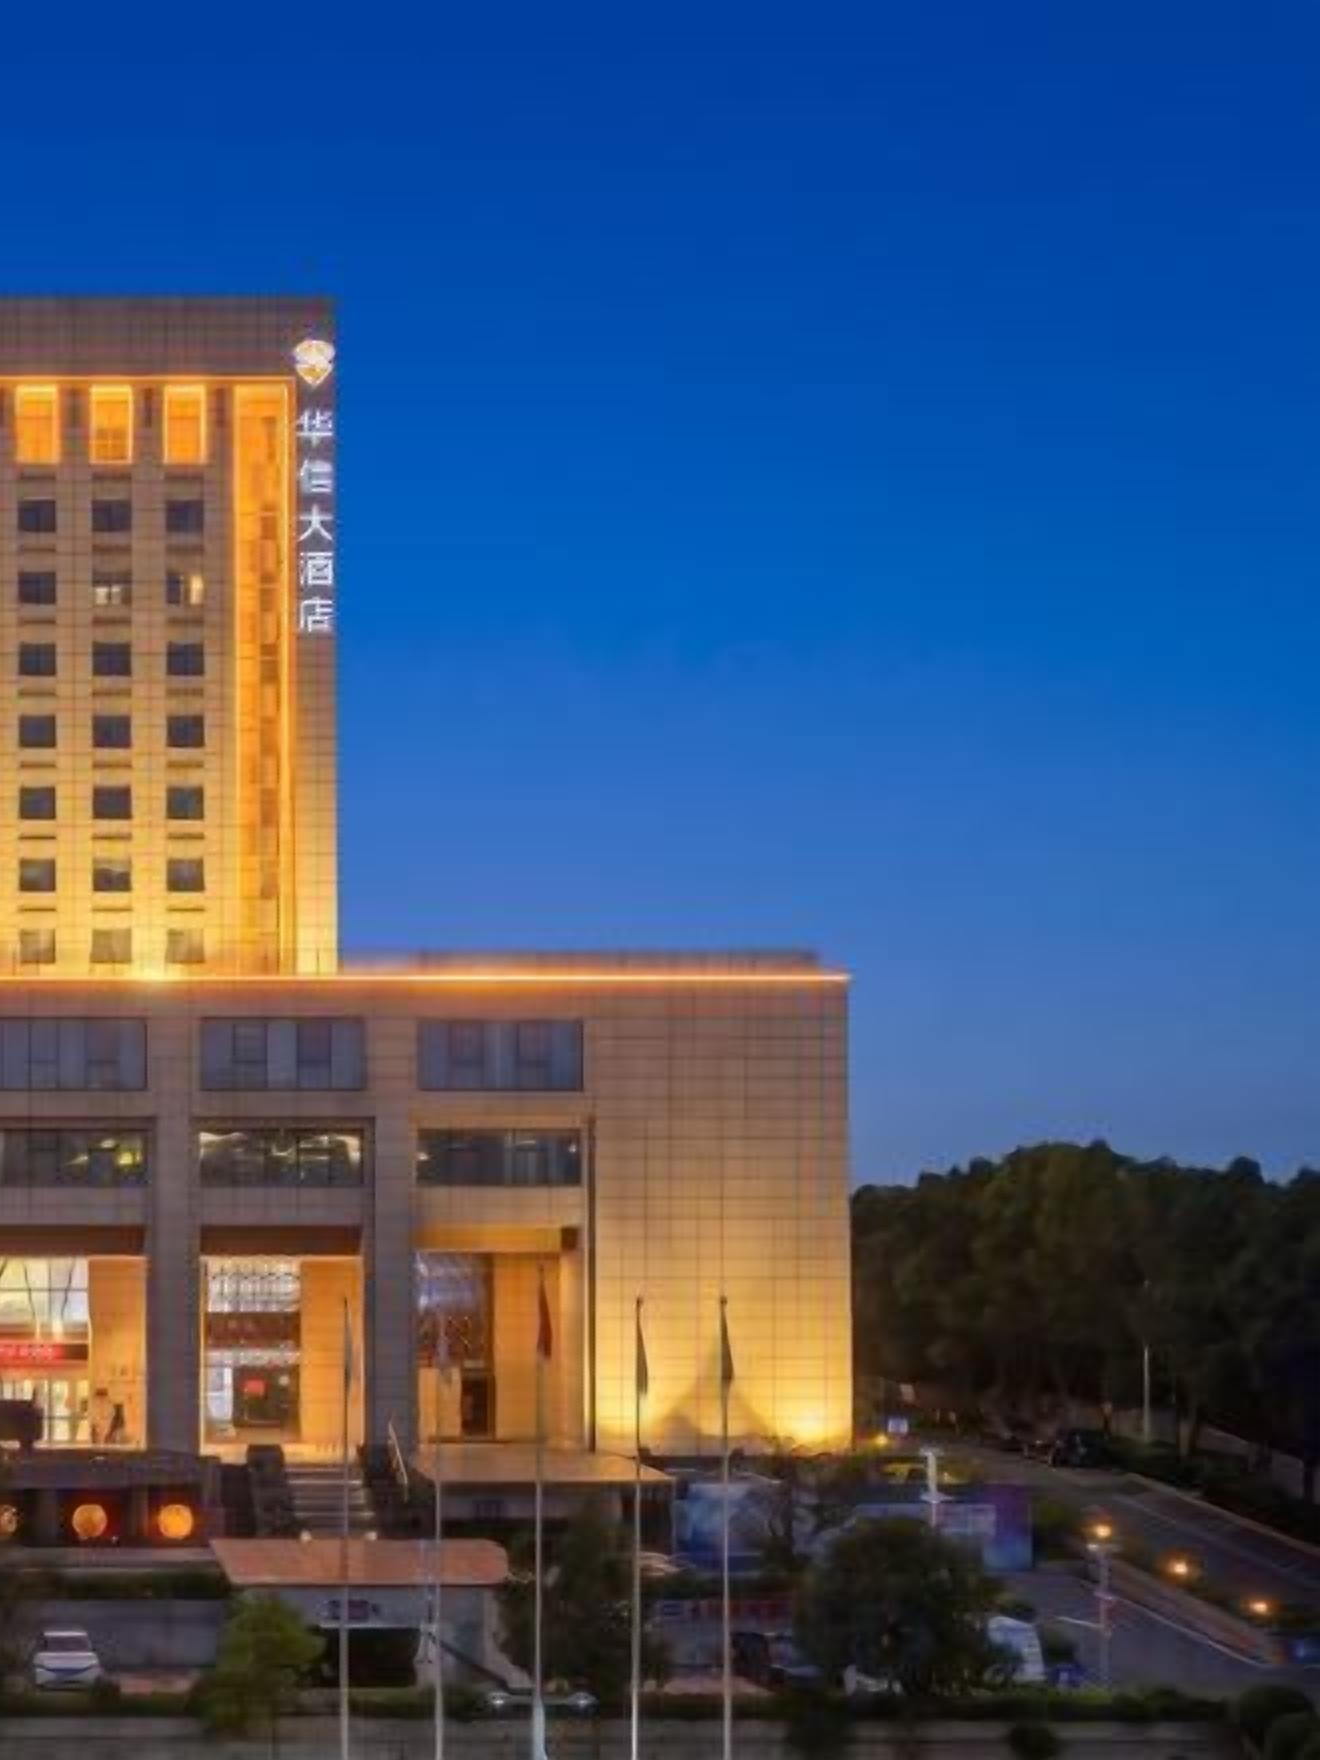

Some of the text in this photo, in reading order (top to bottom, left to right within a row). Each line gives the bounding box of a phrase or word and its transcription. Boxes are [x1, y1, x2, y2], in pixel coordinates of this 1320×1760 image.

[296, 407, 333, 632] 华信大酒店
